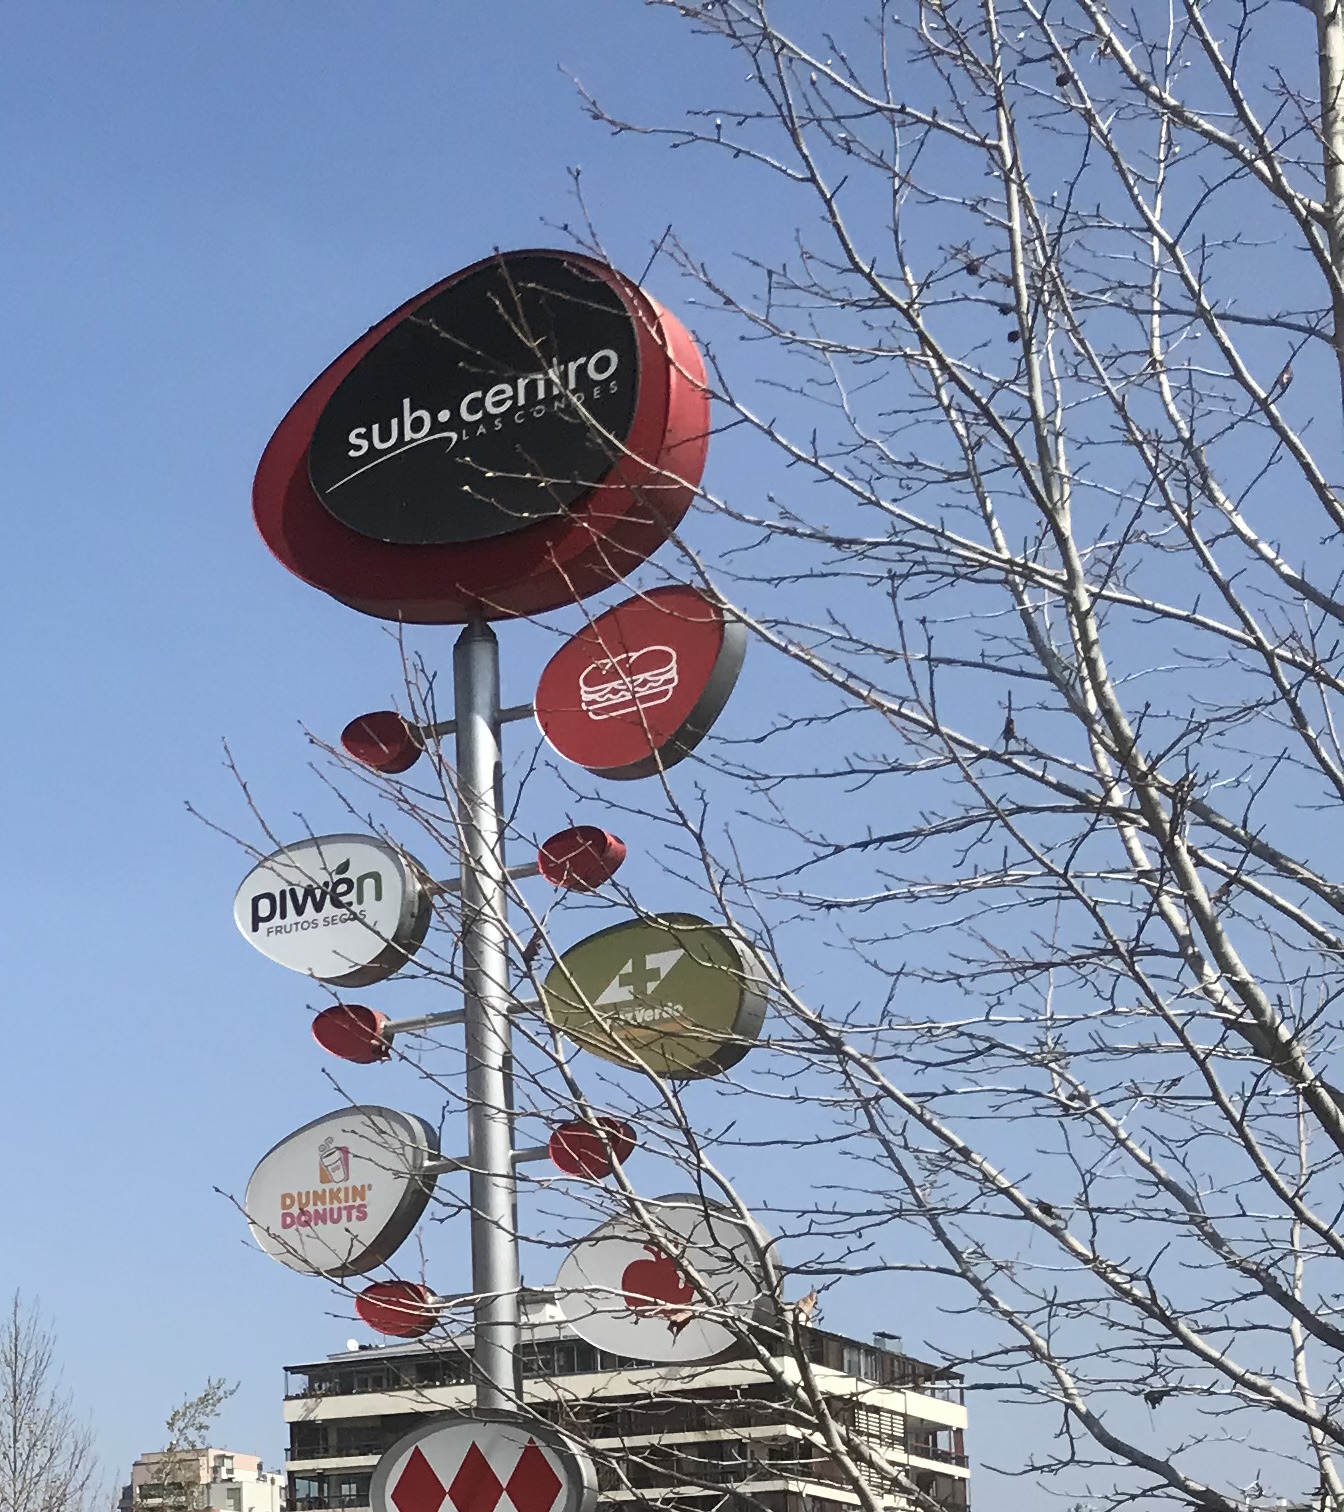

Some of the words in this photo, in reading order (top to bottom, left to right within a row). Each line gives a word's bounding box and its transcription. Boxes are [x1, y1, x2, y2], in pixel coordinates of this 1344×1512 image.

[462, 418, 503, 442] LAS
[514, 380, 618, 425] CONDES
[251, 859, 383, 933] piwén
[266, 918, 319, 938] FRUTOS
[322, 909, 367, 928] SECOS
[280, 1183, 373, 1211] DUNKIN'
[280, 1203, 368, 1230] DONUTS
